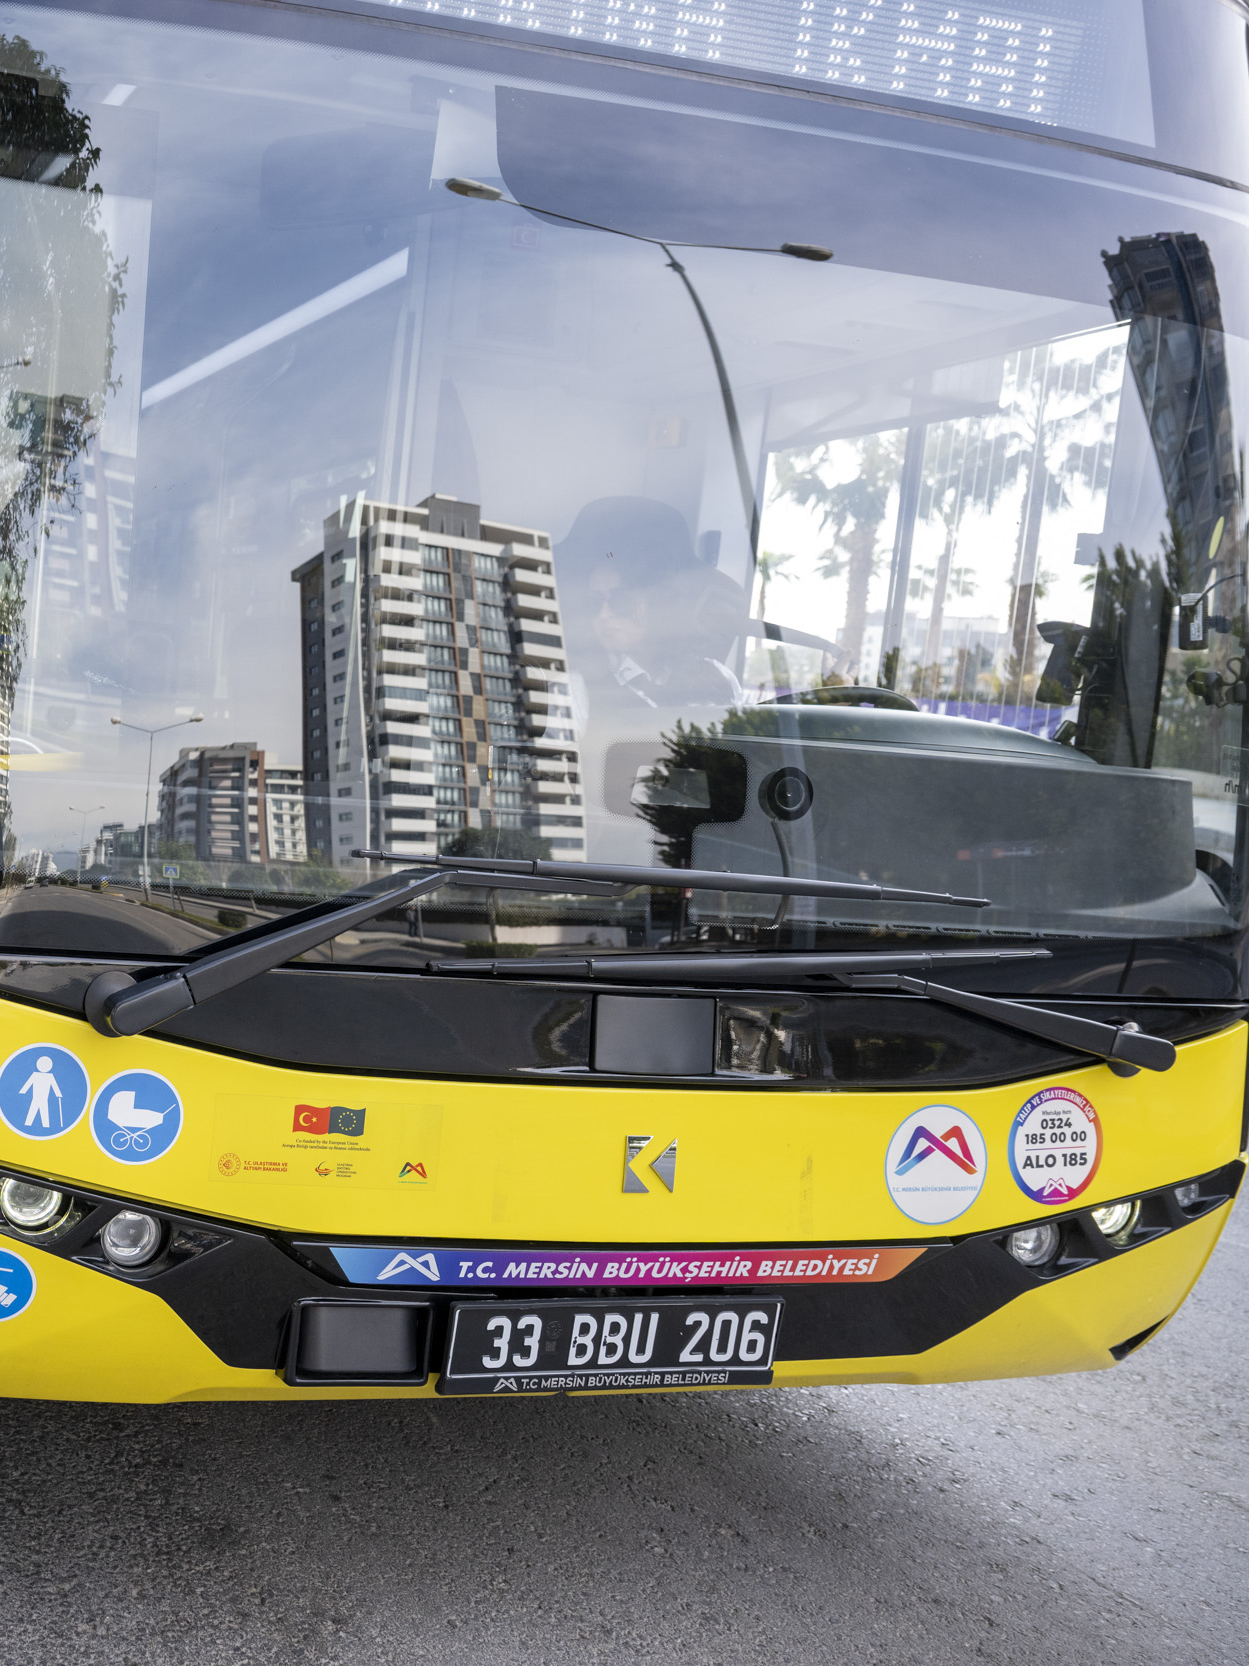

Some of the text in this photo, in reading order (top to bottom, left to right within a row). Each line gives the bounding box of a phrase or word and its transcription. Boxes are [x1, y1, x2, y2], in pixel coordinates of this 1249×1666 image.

[1016, 1103, 1032, 1123] TALEP
[1031, 1095, 1041, 1106] VE
[1040, 1117, 1072, 1130] 0324
[1025, 1130, 1087, 1145] 185 00 00
[1022, 1152, 1088, 1169] ALO 185
[457, 1253, 878, 1283] T.C. MERSİN BÜYÜKŞEHİR BELEDİYESİ
[482, 1311, 768, 1368] 33 BBU 206
[521, 1371, 729, 1389] T.C MERSİN BÜYÜKŞEHİR BELEDİYESİ
